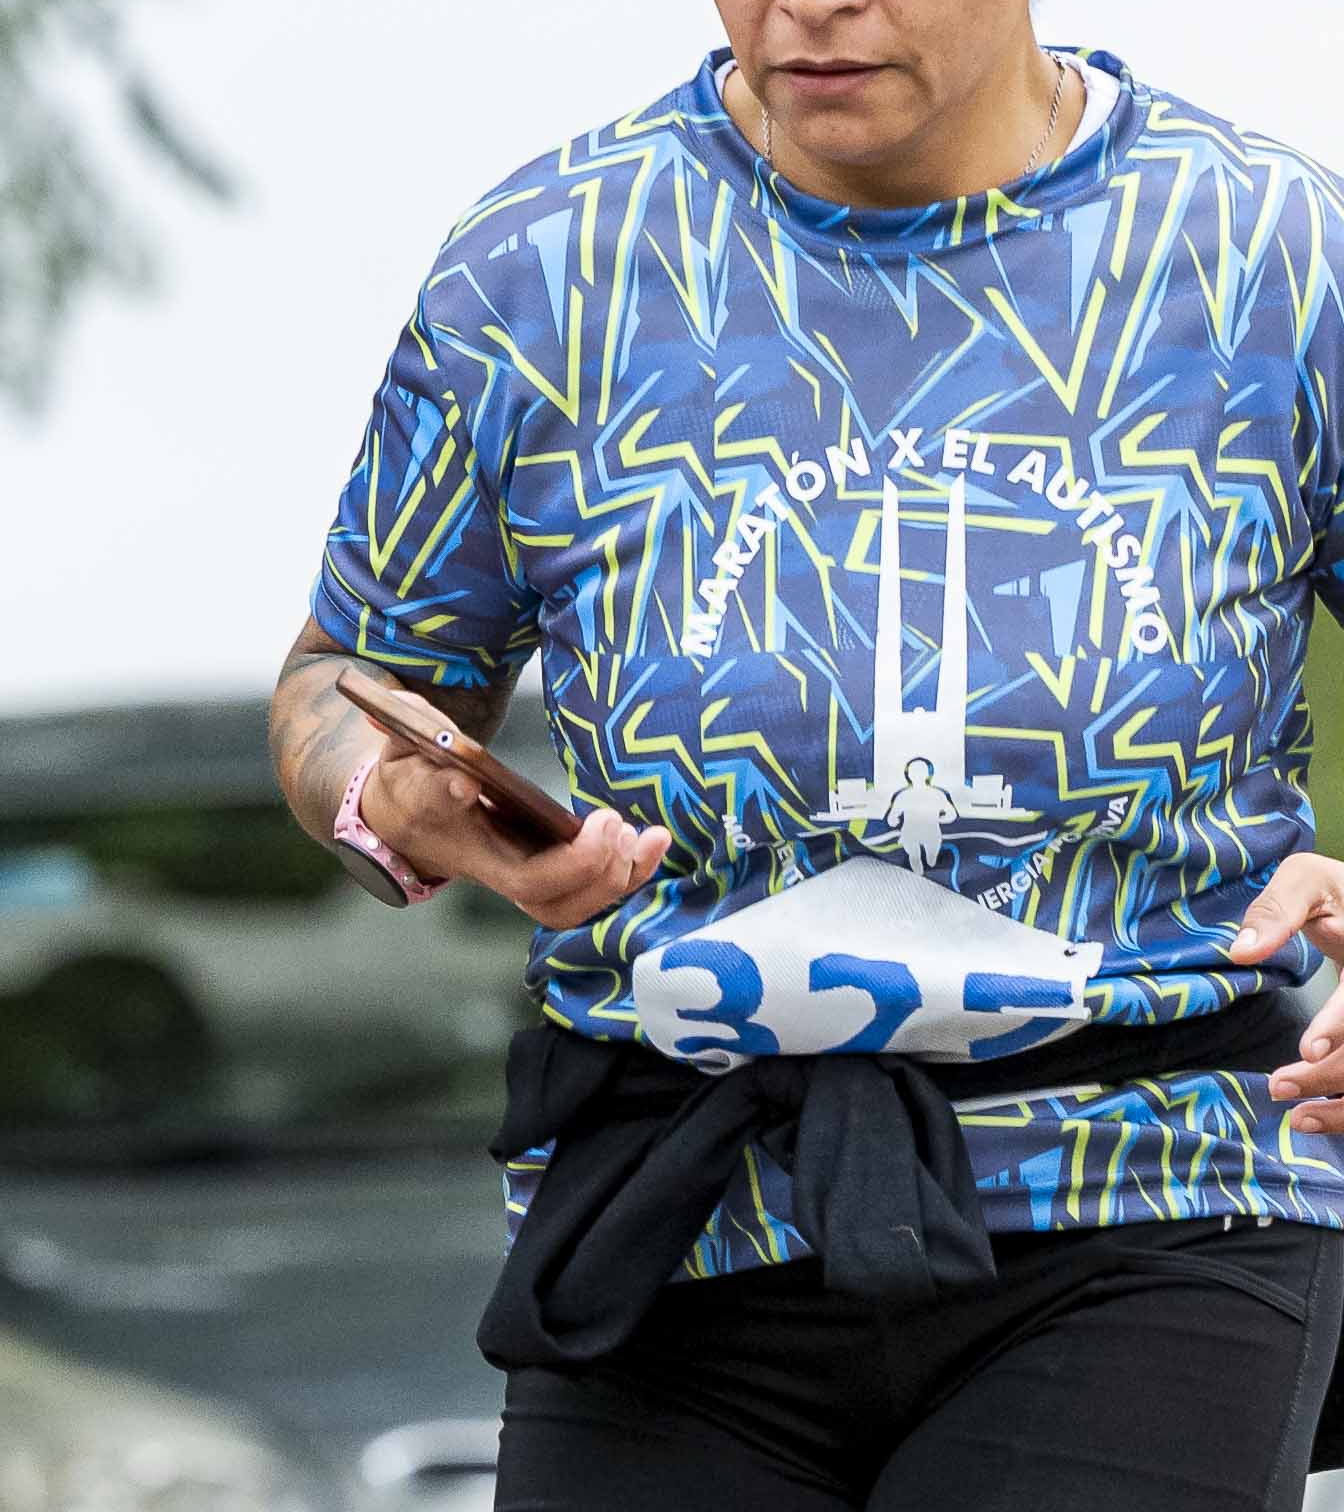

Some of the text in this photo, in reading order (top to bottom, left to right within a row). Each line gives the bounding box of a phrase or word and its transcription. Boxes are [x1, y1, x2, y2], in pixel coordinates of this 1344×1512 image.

[680, 427, 1168, 659] MARATÓN X EL AUTISMO
